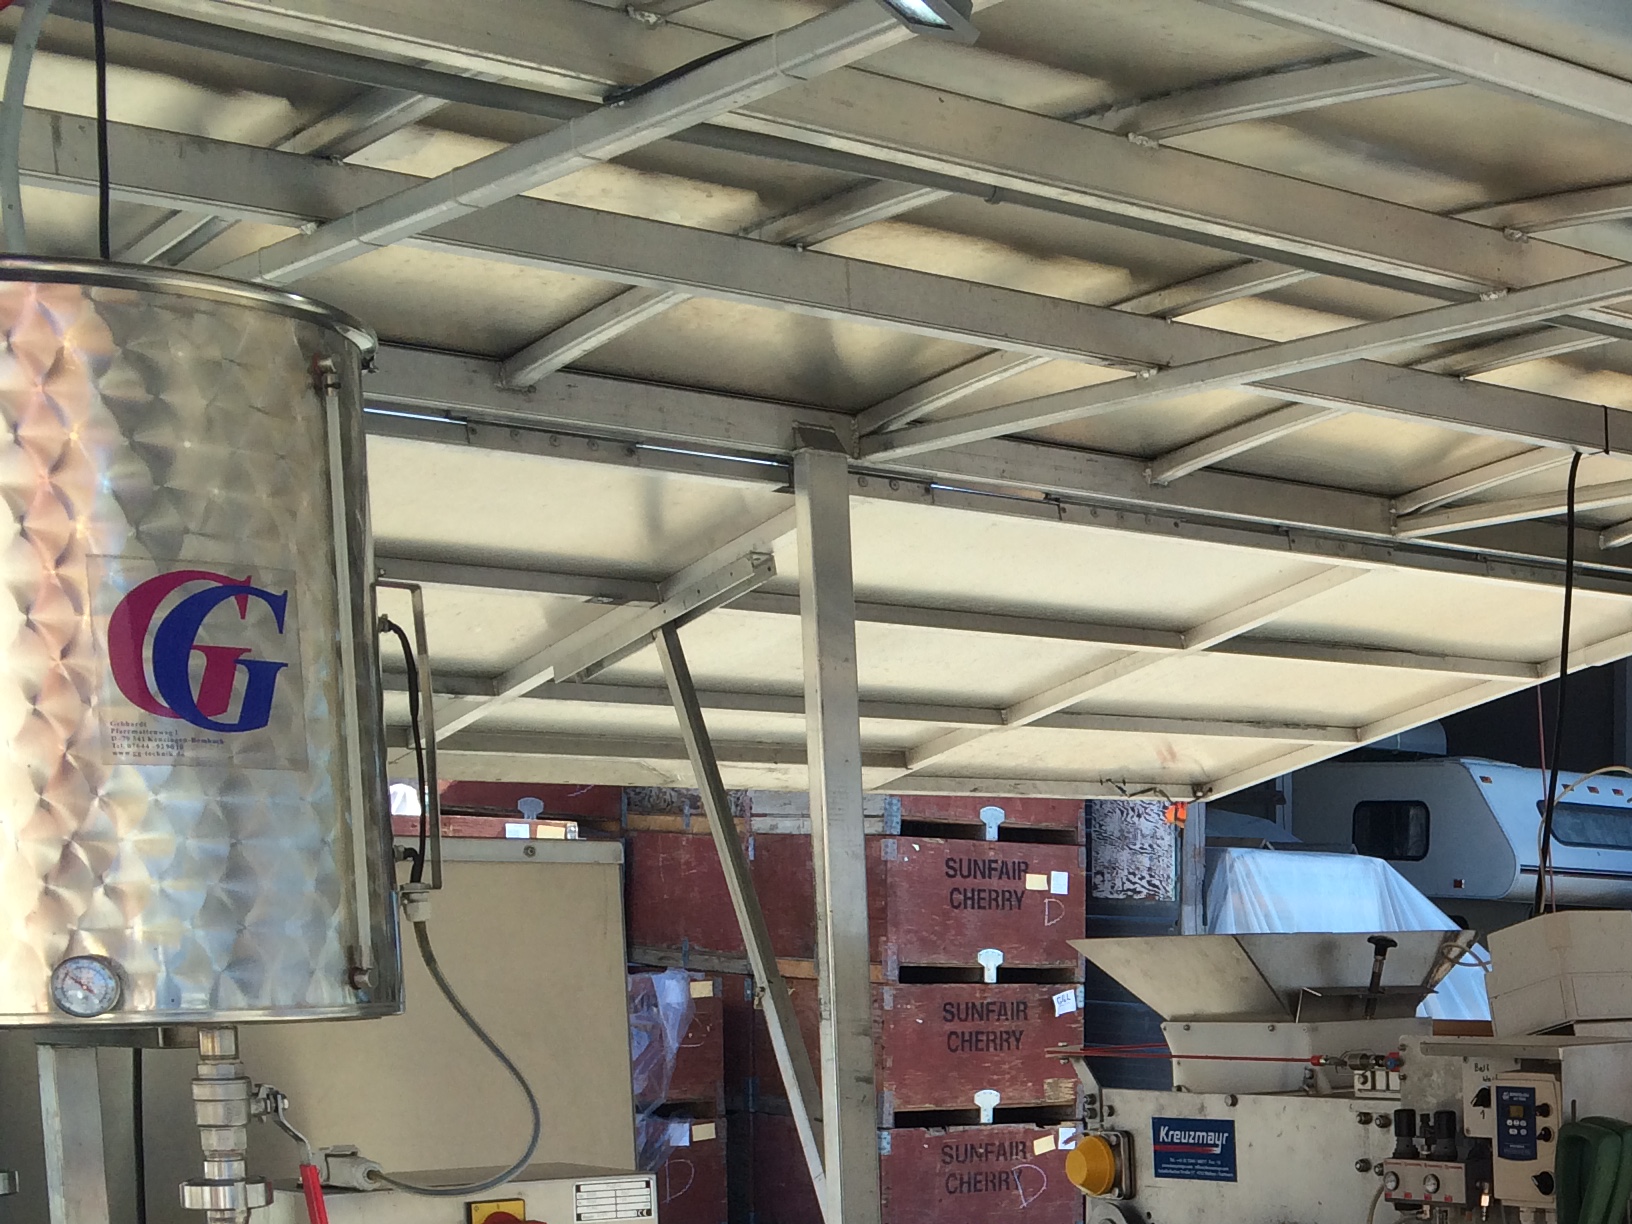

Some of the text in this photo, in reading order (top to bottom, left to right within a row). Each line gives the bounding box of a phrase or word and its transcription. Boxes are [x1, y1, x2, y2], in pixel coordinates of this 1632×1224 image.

[945, 857, 1029, 880] SUNFAIR
[950, 887, 1025, 910] CHERRY
[1043, 898, 1065, 926] D
[942, 1001, 1029, 1022] SUNFAIR
[946, 1029, 1025, 1053] CHERRY
[941, 1140, 1028, 1165] SUNFAIR
[1160, 1126, 1229, 1154] Kreuzmayr
[945, 1169, 1023, 1194] CHERRY
[1011, 1163, 1047, 1209] D
